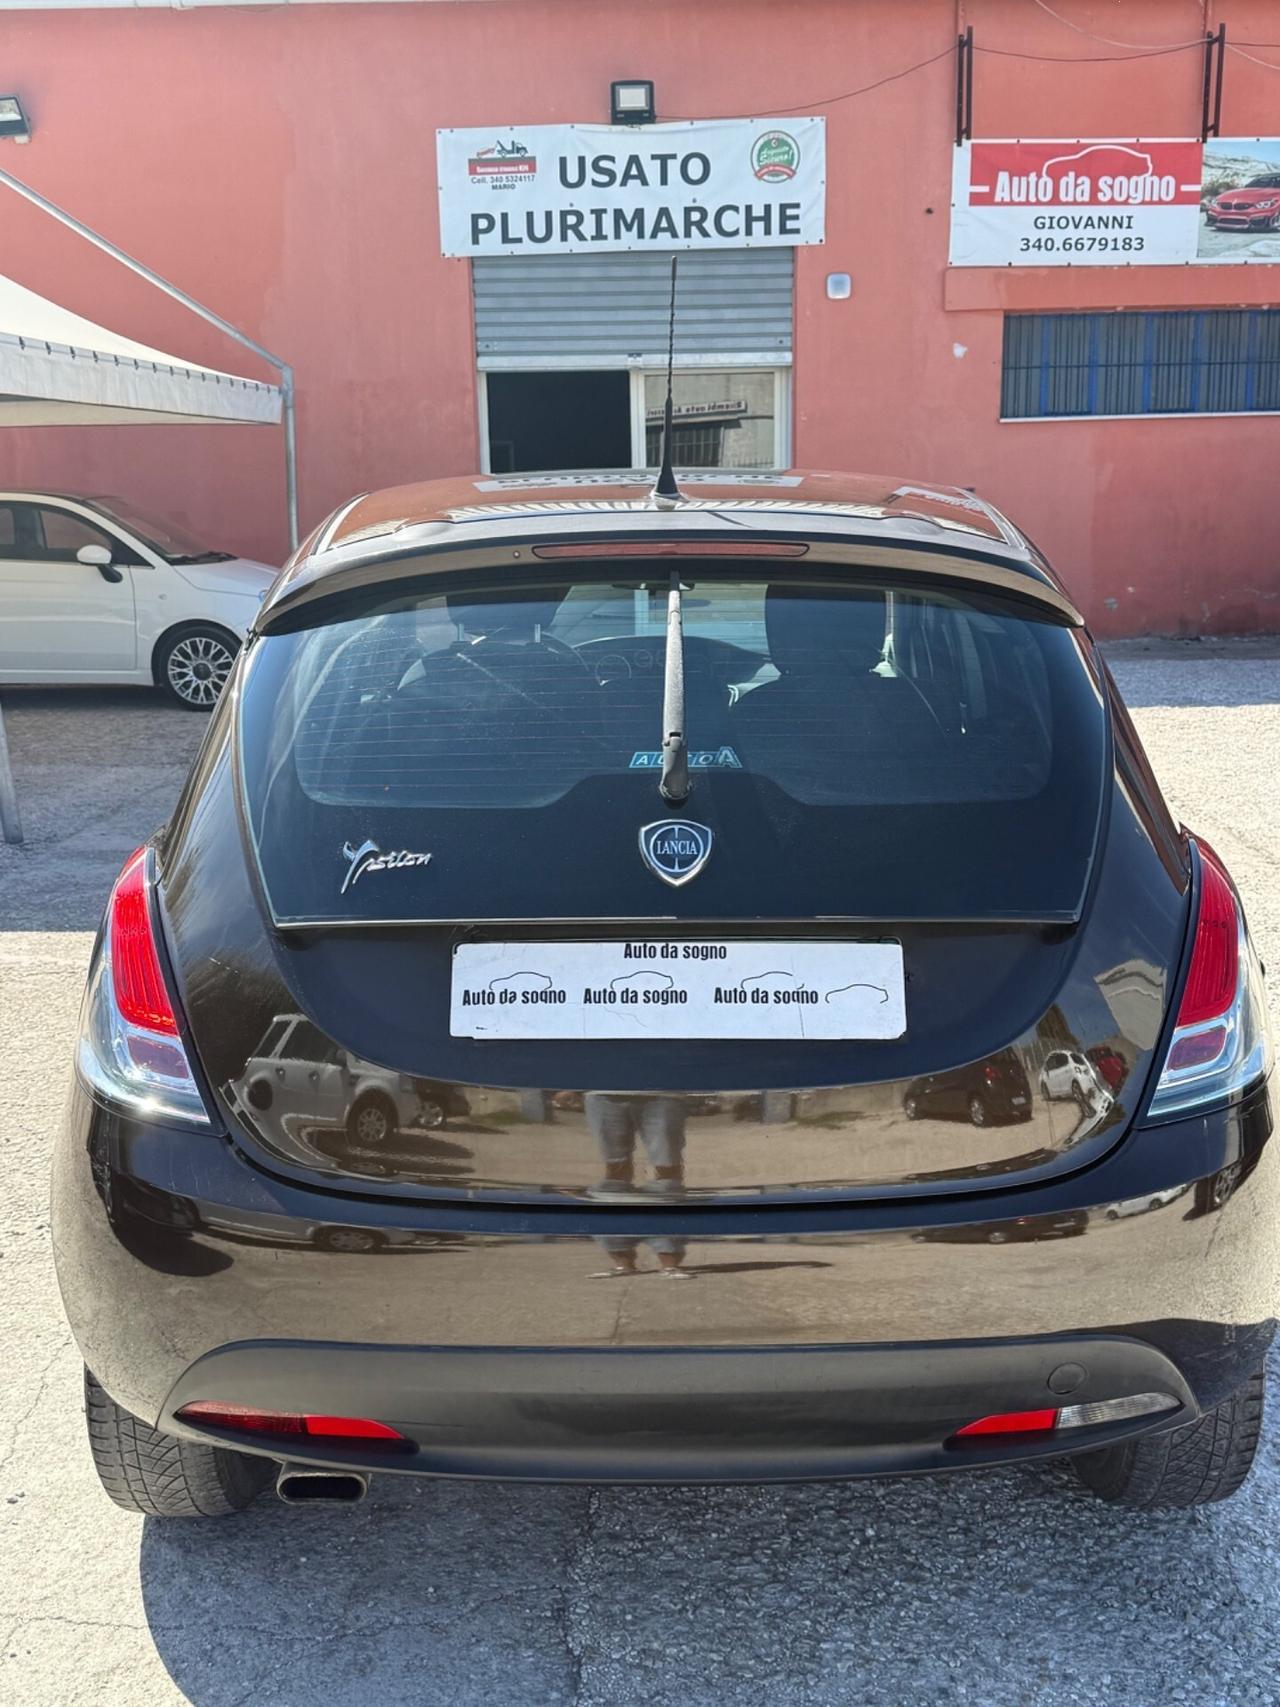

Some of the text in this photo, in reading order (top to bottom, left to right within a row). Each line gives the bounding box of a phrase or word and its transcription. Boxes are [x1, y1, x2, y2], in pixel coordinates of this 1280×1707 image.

[558, 151, 711, 189] USATO
[994, 171, 1176, 204] Auto da sogno
[470, 202, 801, 245] PLURIMARCHE
[1033, 215, 1134, 230] GIOVANNI
[1019, 237, 1145, 252] 340.6679183
[656, 840, 698, 855] LANCIA
[624, 943, 727, 961] Auto da sogno
[463, 990, 567, 1006] Auto da sogno
[584, 988, 688, 1005] Auto da sogno
[714, 987, 818, 1004] Auto da sogno
